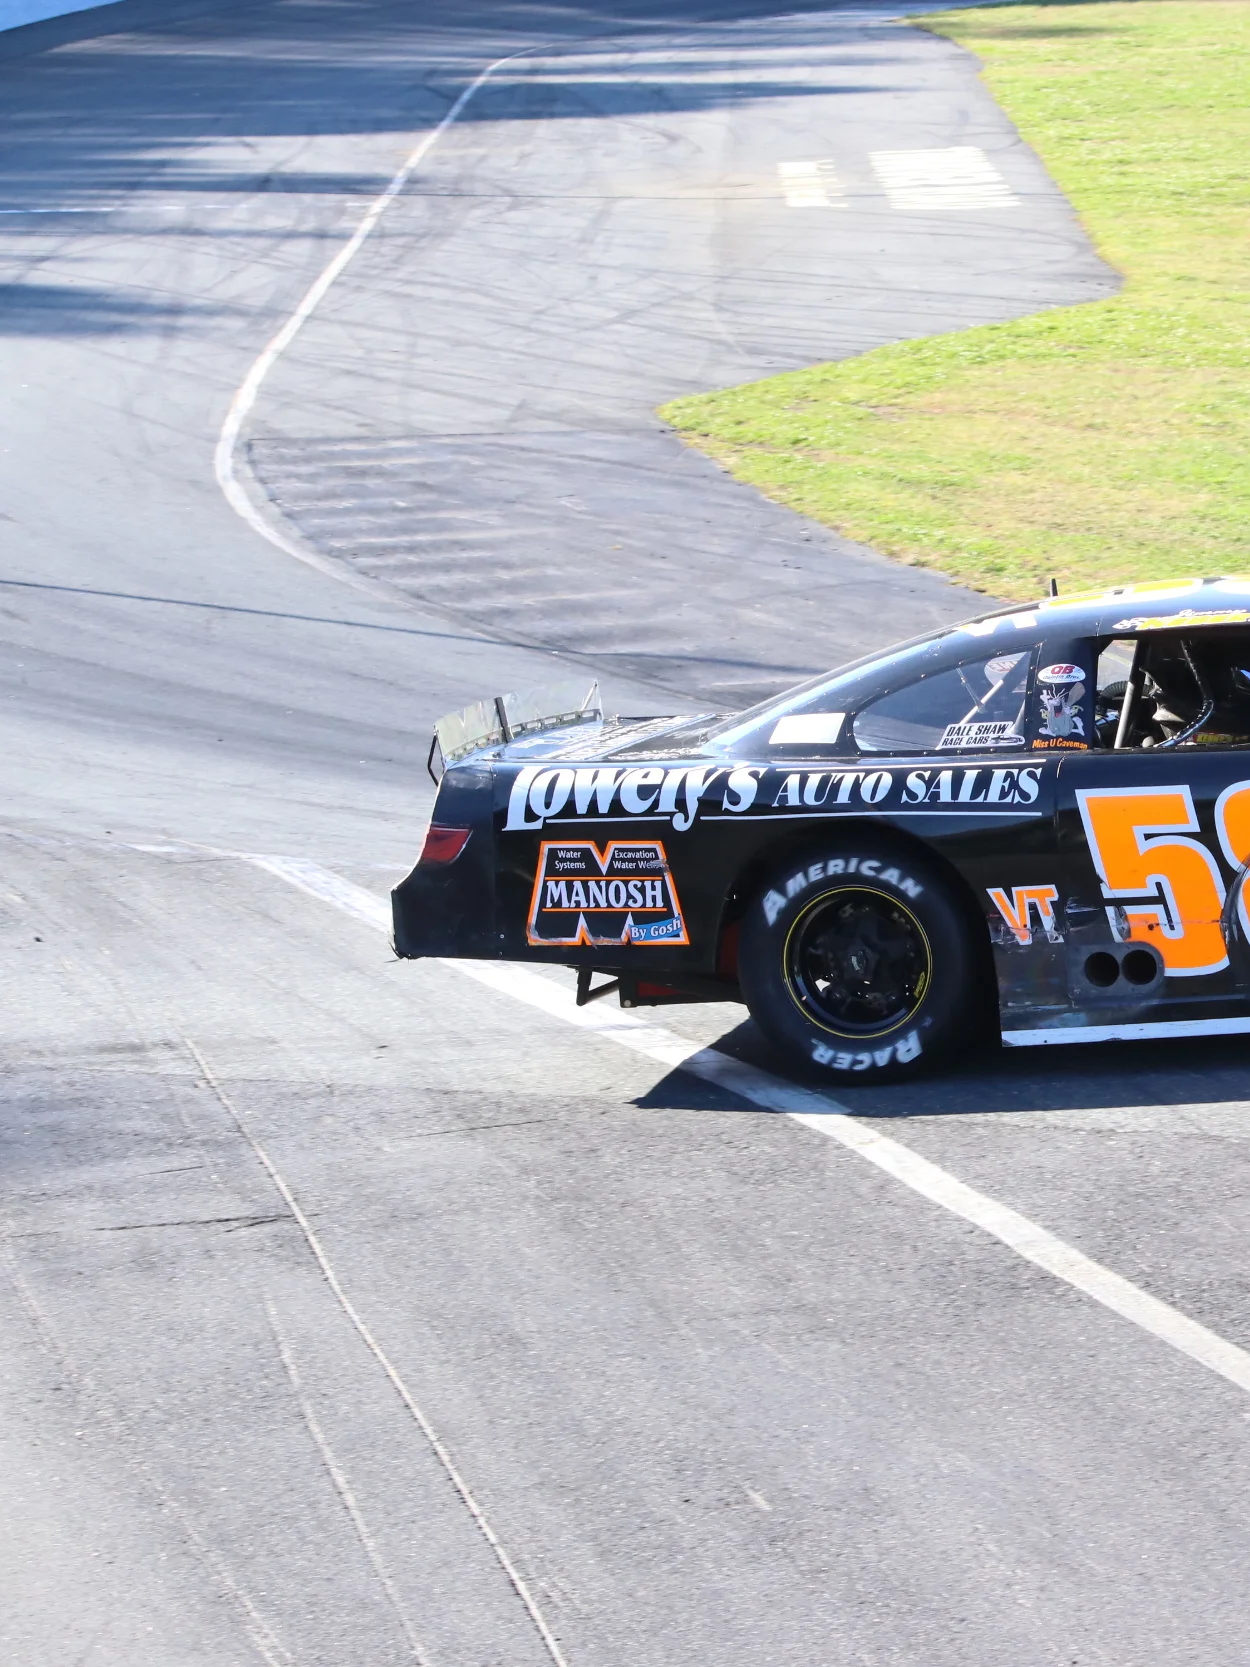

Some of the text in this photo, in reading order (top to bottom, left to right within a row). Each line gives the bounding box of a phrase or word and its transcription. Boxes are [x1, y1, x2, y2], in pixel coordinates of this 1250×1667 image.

[1050, 665, 1076, 675] QB
[946, 723, 1010, 737] DALE SHAW
[941, 735, 989, 747] RACE CARS
[1032, 738, 1089, 750] Miss U Caveman
[772, 771, 893, 807] AUTO
[901, 767, 1042, 805] SALES
[557, 850, 582, 859] Water
[614, 850, 655, 859] Excavation
[555, 861, 586, 871] Systems
[612, 861, 636, 869] Water
[545, 880, 664, 908] MANOSH
[763, 858, 924, 927] AMERICAN
[985, 884, 1065, 945] VT
[631, 919, 681, 941] By Gosh
[811, 1029, 923, 1071] RACER
